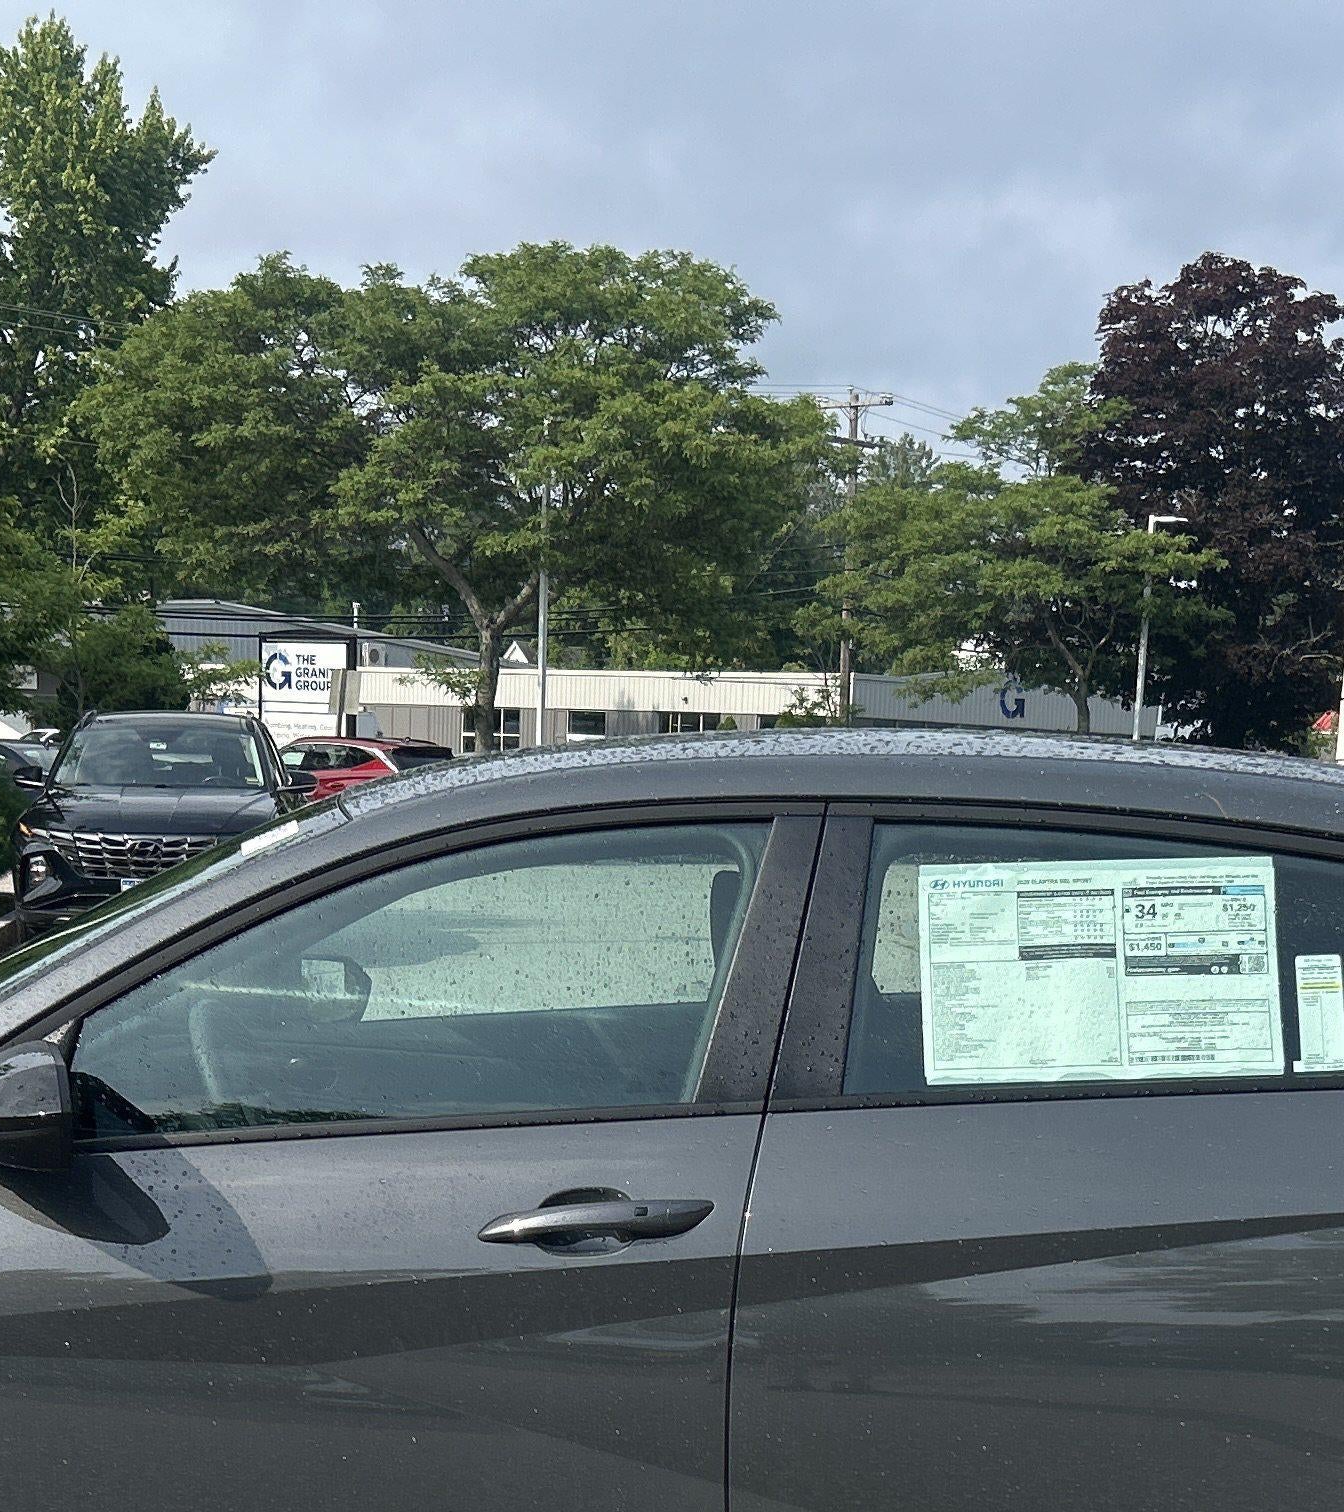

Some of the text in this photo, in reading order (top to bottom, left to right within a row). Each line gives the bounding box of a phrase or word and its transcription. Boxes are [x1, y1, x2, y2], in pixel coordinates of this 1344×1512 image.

[296, 654, 317, 666] THE
[295, 680, 332, 691] GROUP
[952, 879, 1004, 889] HYUNDAI
[1135, 903, 1157, 920] 34
[1129, 942, 1162, 952] $1,450
